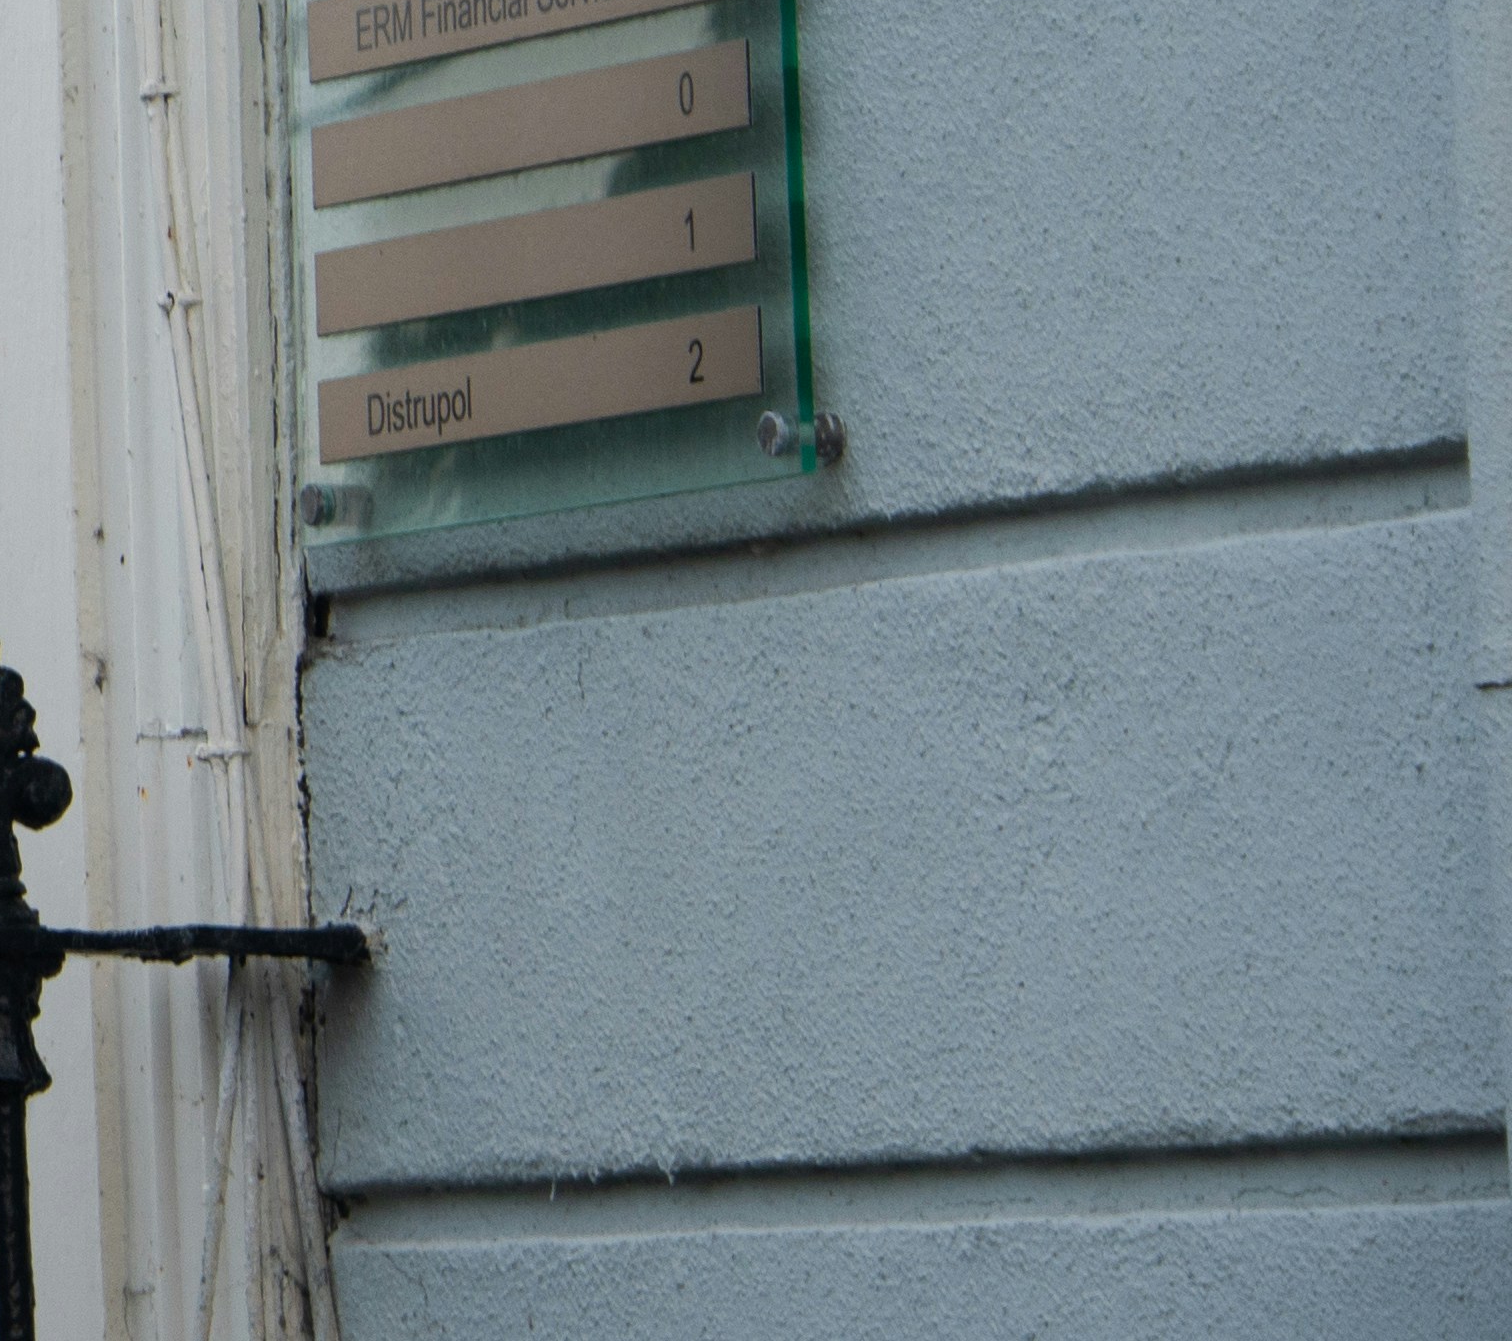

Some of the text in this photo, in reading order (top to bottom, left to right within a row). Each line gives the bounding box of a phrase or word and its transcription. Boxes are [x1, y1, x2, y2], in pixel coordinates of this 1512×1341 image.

[683, 208, 696, 252] 1
[367, 339, 705, 438] Distrupol 2
